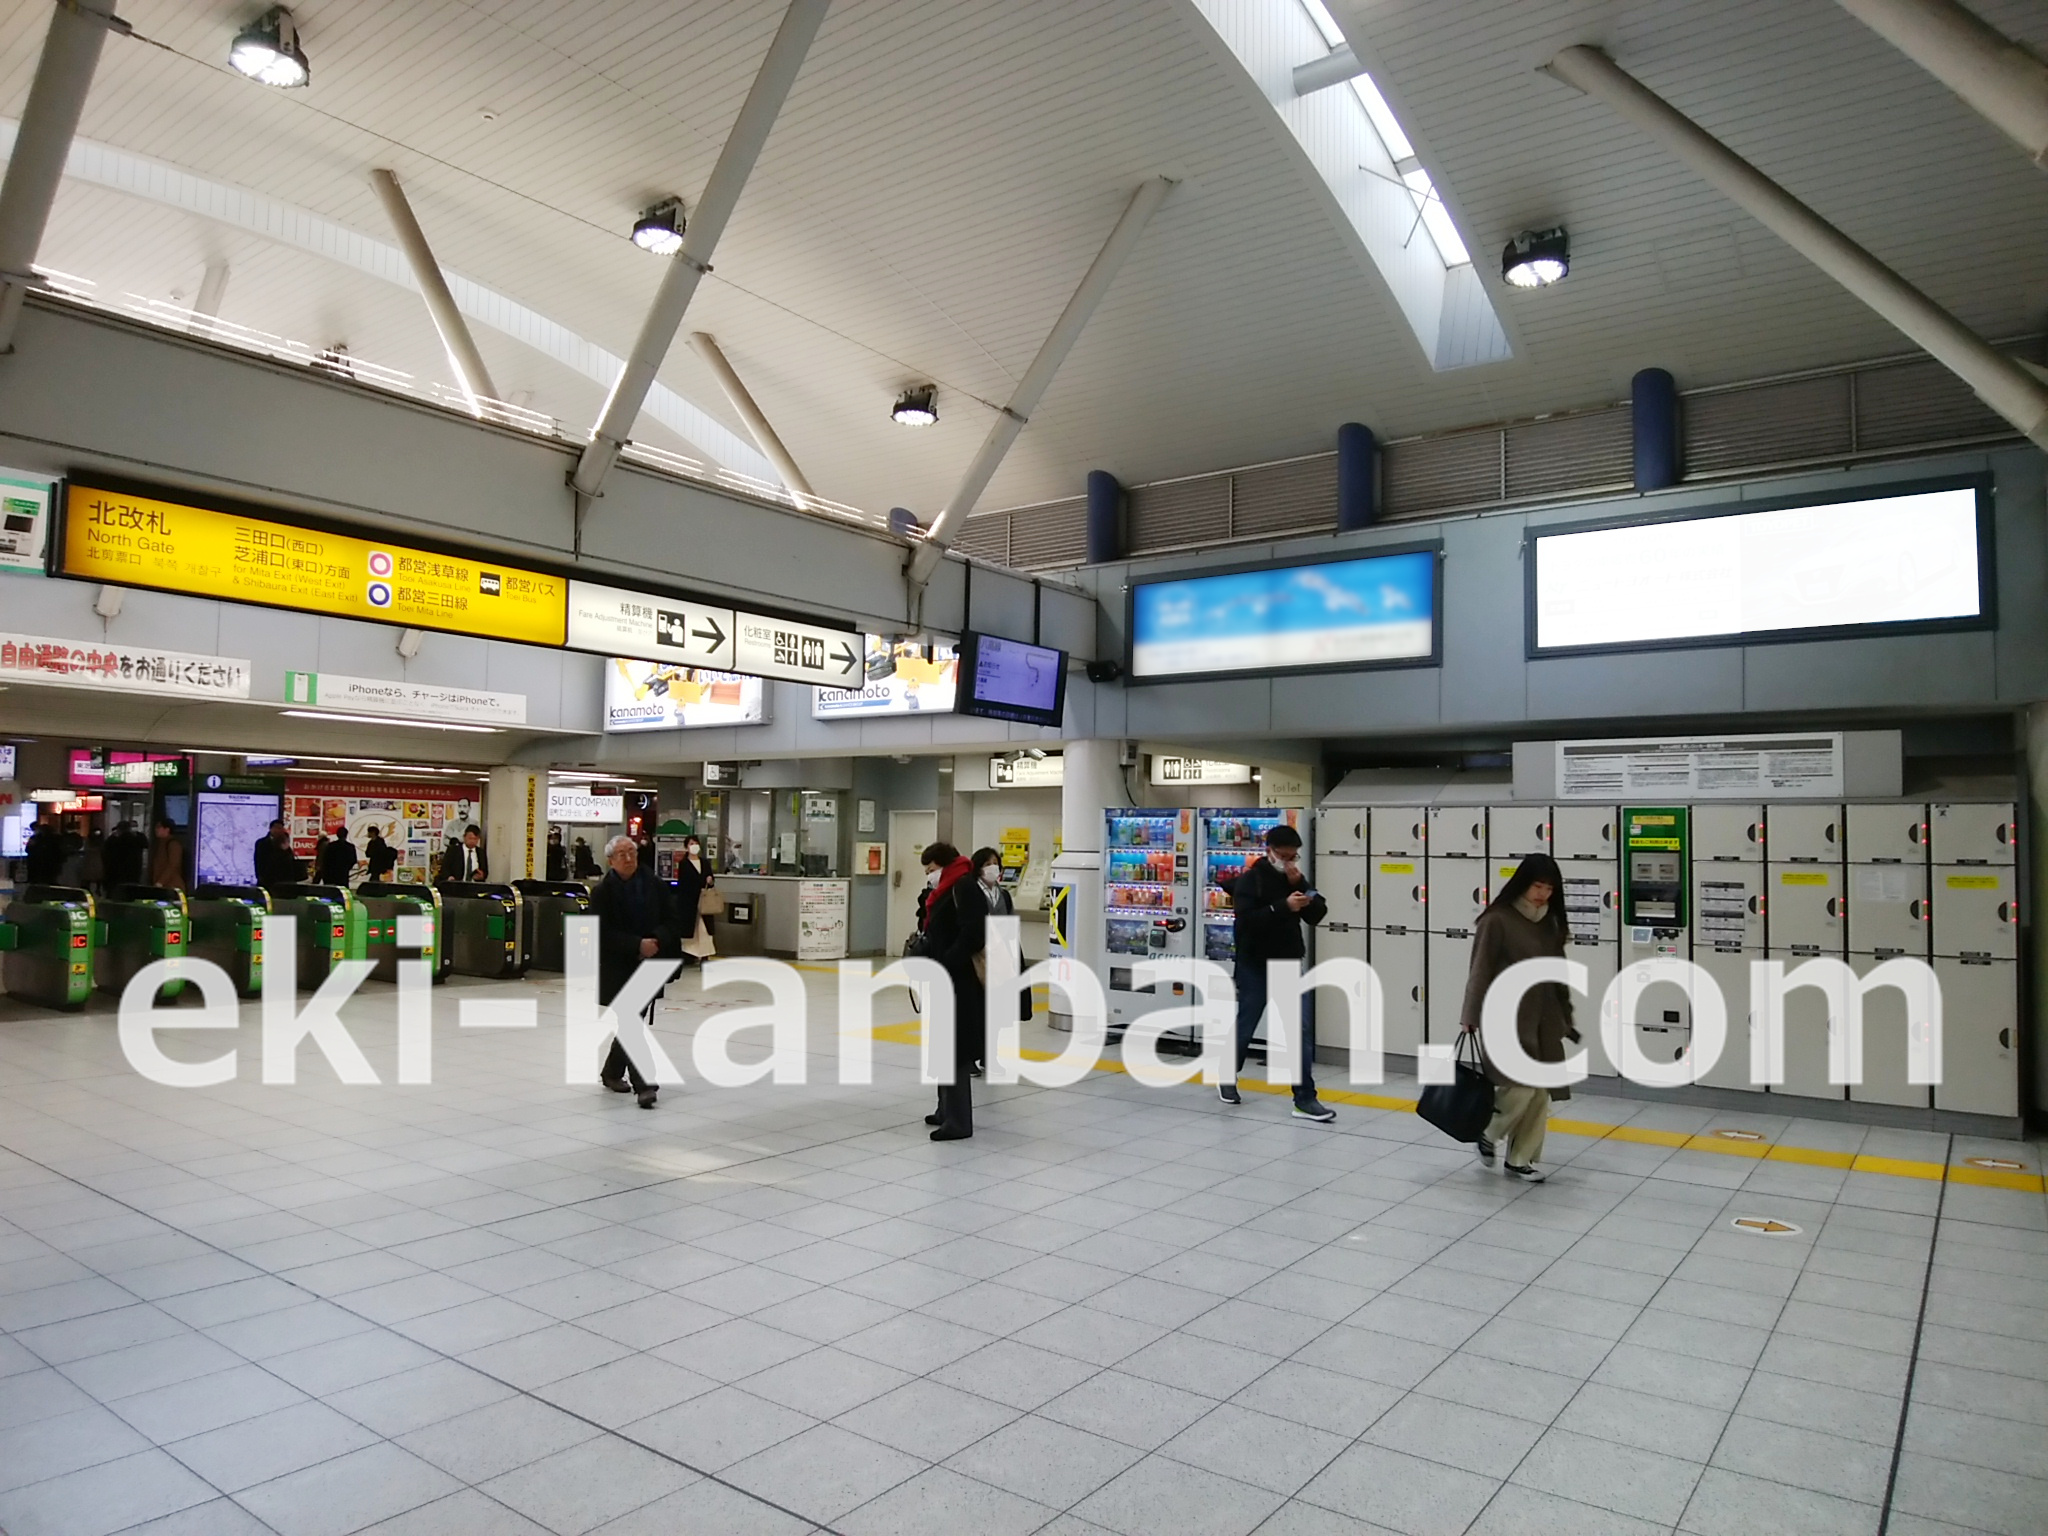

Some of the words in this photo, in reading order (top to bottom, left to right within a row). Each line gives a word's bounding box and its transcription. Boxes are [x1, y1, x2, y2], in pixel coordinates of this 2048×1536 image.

[88, 500, 172, 536] 北改札
[87, 527, 132, 548] North
[137, 536, 175, 555] Gate
[234, 526, 324, 556] 三田口(西口)
[234, 545, 350, 580] 芝浦口(東口)方面
[398, 556, 469, 582] 都営浅草線
[233, 564, 246, 574] for
[249, 566, 271, 579] Mita
[273, 570, 292, 582] Exit
[295, 572, 322, 586] (West
[325, 578, 346, 590] Exit)
[418, 577, 452, 590] Asakusa
[454, 581, 471, 592] Line
[232, 576, 240, 585] &
[243, 576, 288, 592] Shibaura
[290, 583, 308, 595] Exit
[311, 588, 336, 600] (East
[338, 594, 359, 604] Exit)
[505, 576, 556, 598] 都営バス
[397, 586, 468, 611] 都営三田線
[522, 594, 537, 604] Bus
[416, 605, 434, 616] Mita
[436, 609, 454, 619] Line
[578, 608, 593, 620] Fare
[594, 612, 629, 626] Adjustment
[629, 617, 653, 629] Machine
[620, 602, 653, 620] 精算機
[744, 625, 772, 641] 化粧室
[818, 684, 890, 703] kanamoto
[609, 703, 664, 718] kanamoto
[1272, 781, 1301, 793] toilet
[551, 795, 573, 806] SUIT
[574, 796, 620, 808] COMPANY
[70, 910, 88, 920] IC
[165, 908, 181, 918] IC
[73, 935, 87, 948] IC
[167, 932, 180, 944] IC
